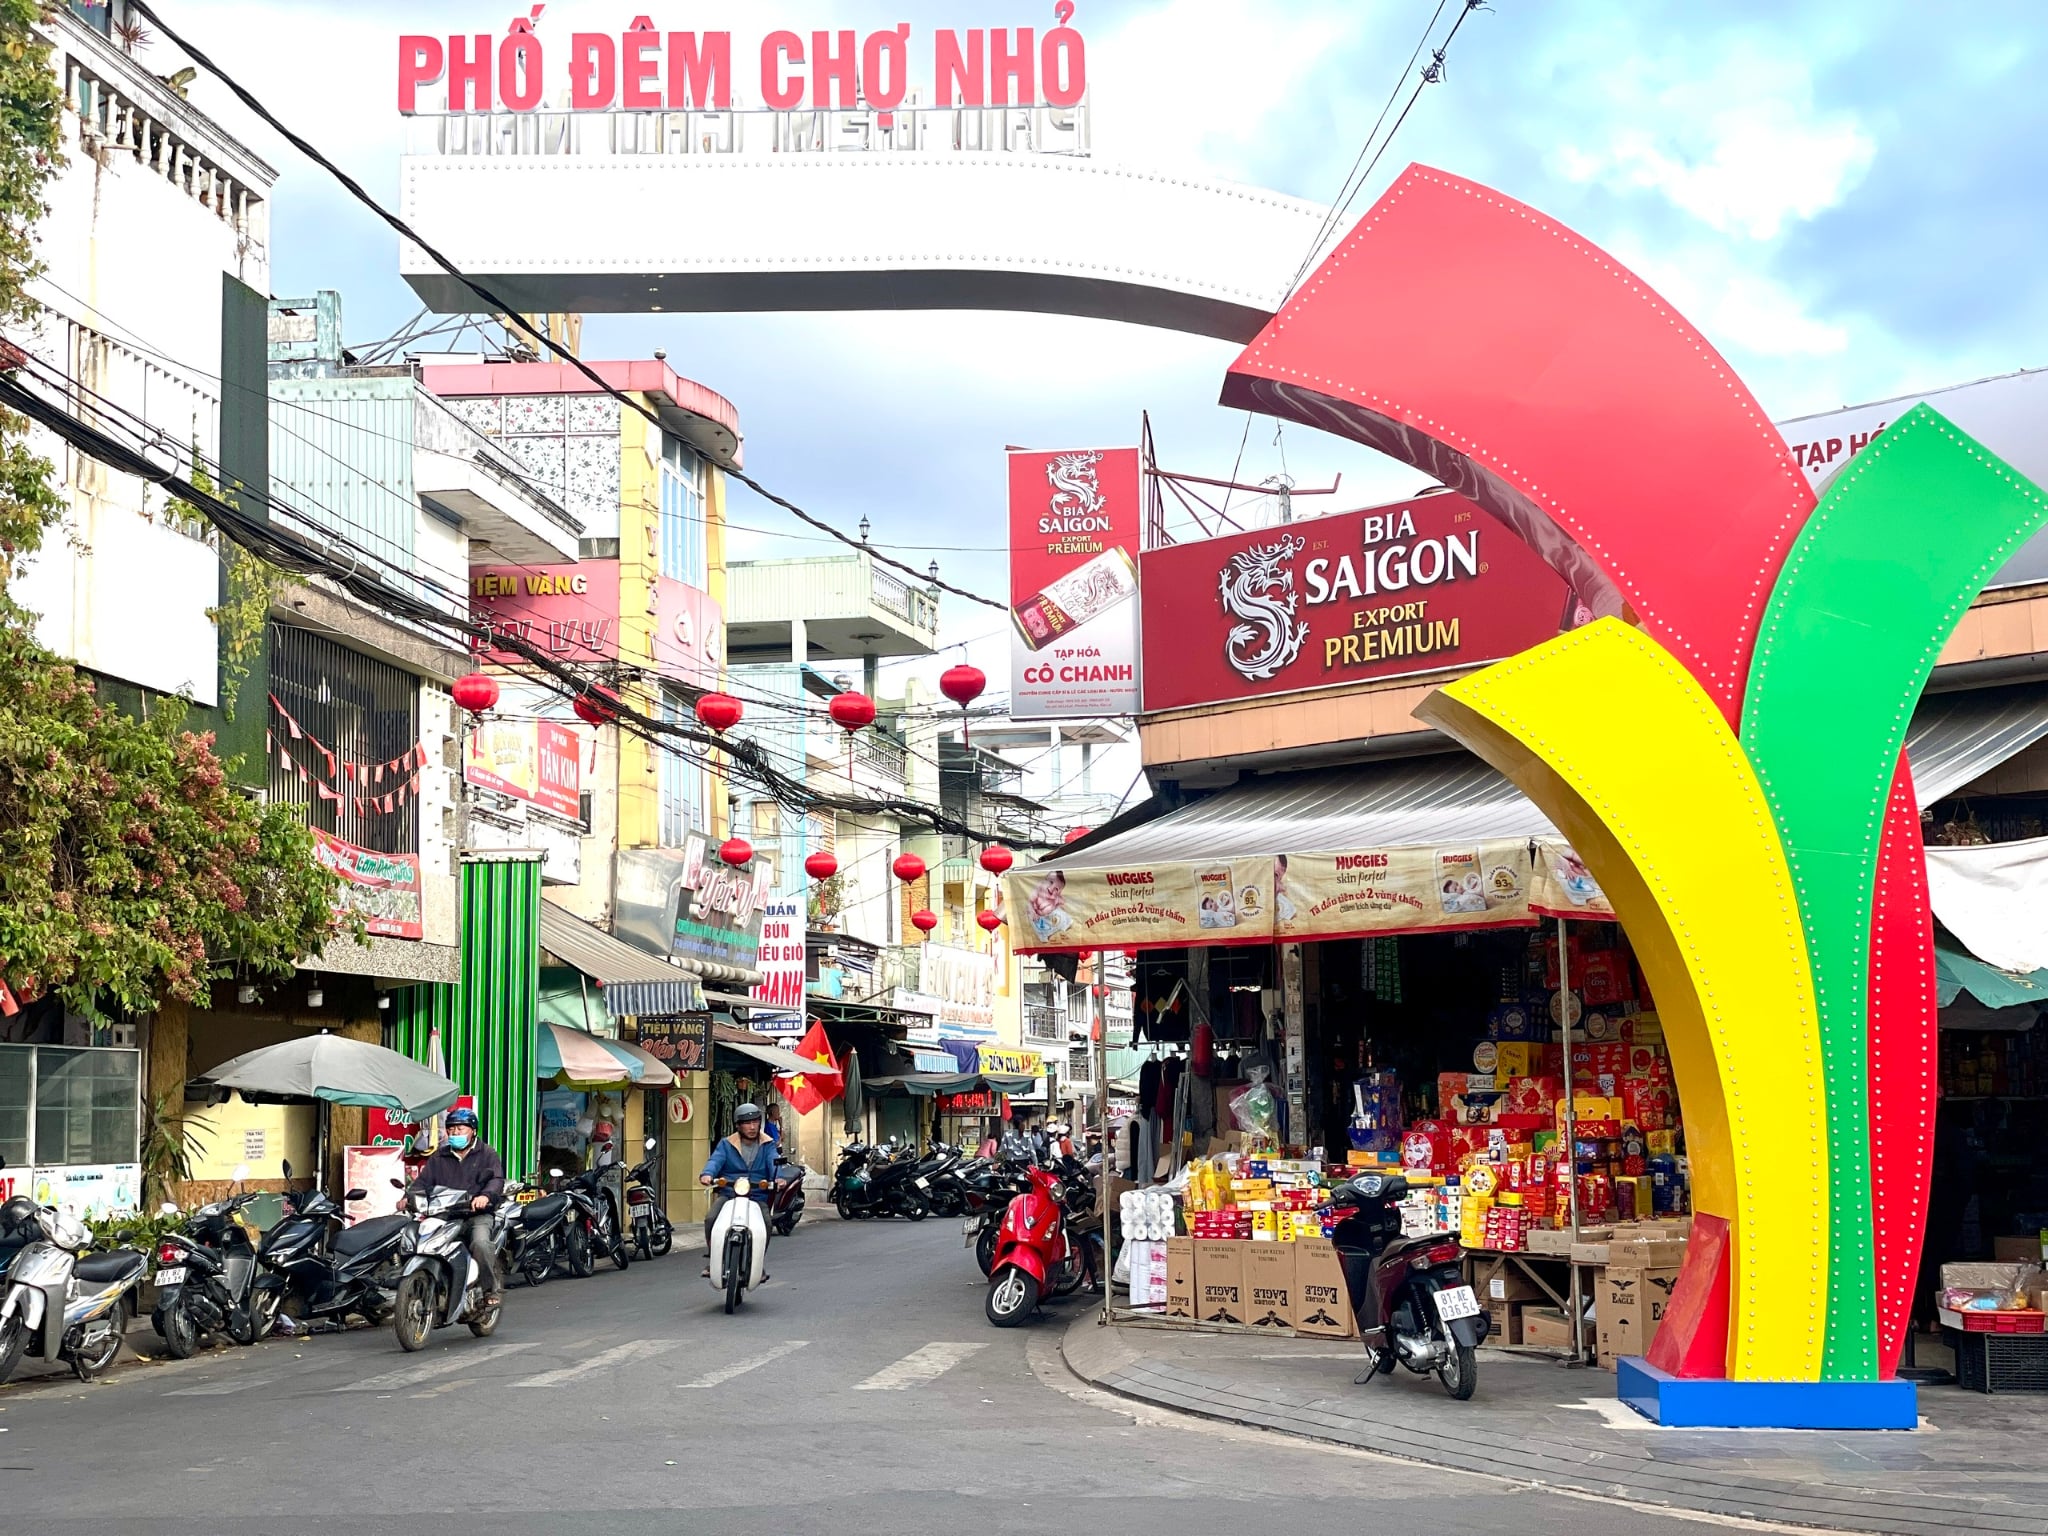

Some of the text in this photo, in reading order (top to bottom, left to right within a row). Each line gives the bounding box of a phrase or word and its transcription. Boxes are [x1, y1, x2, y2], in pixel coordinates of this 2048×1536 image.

[399, 4, 546, 113] PHỐ
[569, 15, 731, 111] ĐÊM
[761, 23, 911, 130] CHỢ
[936, 0, 1087, 109] NHỎ
[1793, 438, 1842, 473] TẠP
[1063, 506, 1085, 517] BIA
[1454, 511, 1472, 523] 1875
[1039, 516, 1109, 533] SAIGON
[1363, 509, 1417, 544] BIA
[1048, 542, 1103, 554] PREMIUM
[1305, 530, 1480, 605] SAIGON
[525, 570, 588, 596] VÀNG
[1353, 601, 1428, 628] EXPORT
[1325, 617, 1460, 667] PREMIUM
[1054, 645, 1101, 661] TẠP HÓA
[1023, 662, 1133, 684] CÔ CHANH
[540, 742, 559, 785] TÂN
[561, 755, 577, 791] KIM
[1335, 854, 1388, 870] HUGGIES
[1442, 854, 1473, 864] HUGGIES
[1106, 871, 1154, 886] HUGGIES
[1336, 869, 1387, 886] skin perfect
[1110, 888, 1129, 899] skin
[1366, 887, 1373, 899] 2
[763, 902, 797, 916] UÁN
[1137, 902, 1144, 913] 2
[764, 921, 790, 939] BÚN
[758, 943, 780, 961] IÊU
[783, 942, 803, 961] GIÒ
[643, 1020, 703, 1037] TIỆM VÀNG
[988, 1051, 1004, 1071] BÚN
[1006, 1056, 1020, 1073] CUA
[1204, 1285, 1239, 1303] EAGLE
[1253, 1288, 1288, 1307] EAGLE
[1304, 1285, 1338, 1304] EAGLE
[1611, 1292, 1635, 1305] EAGLE
